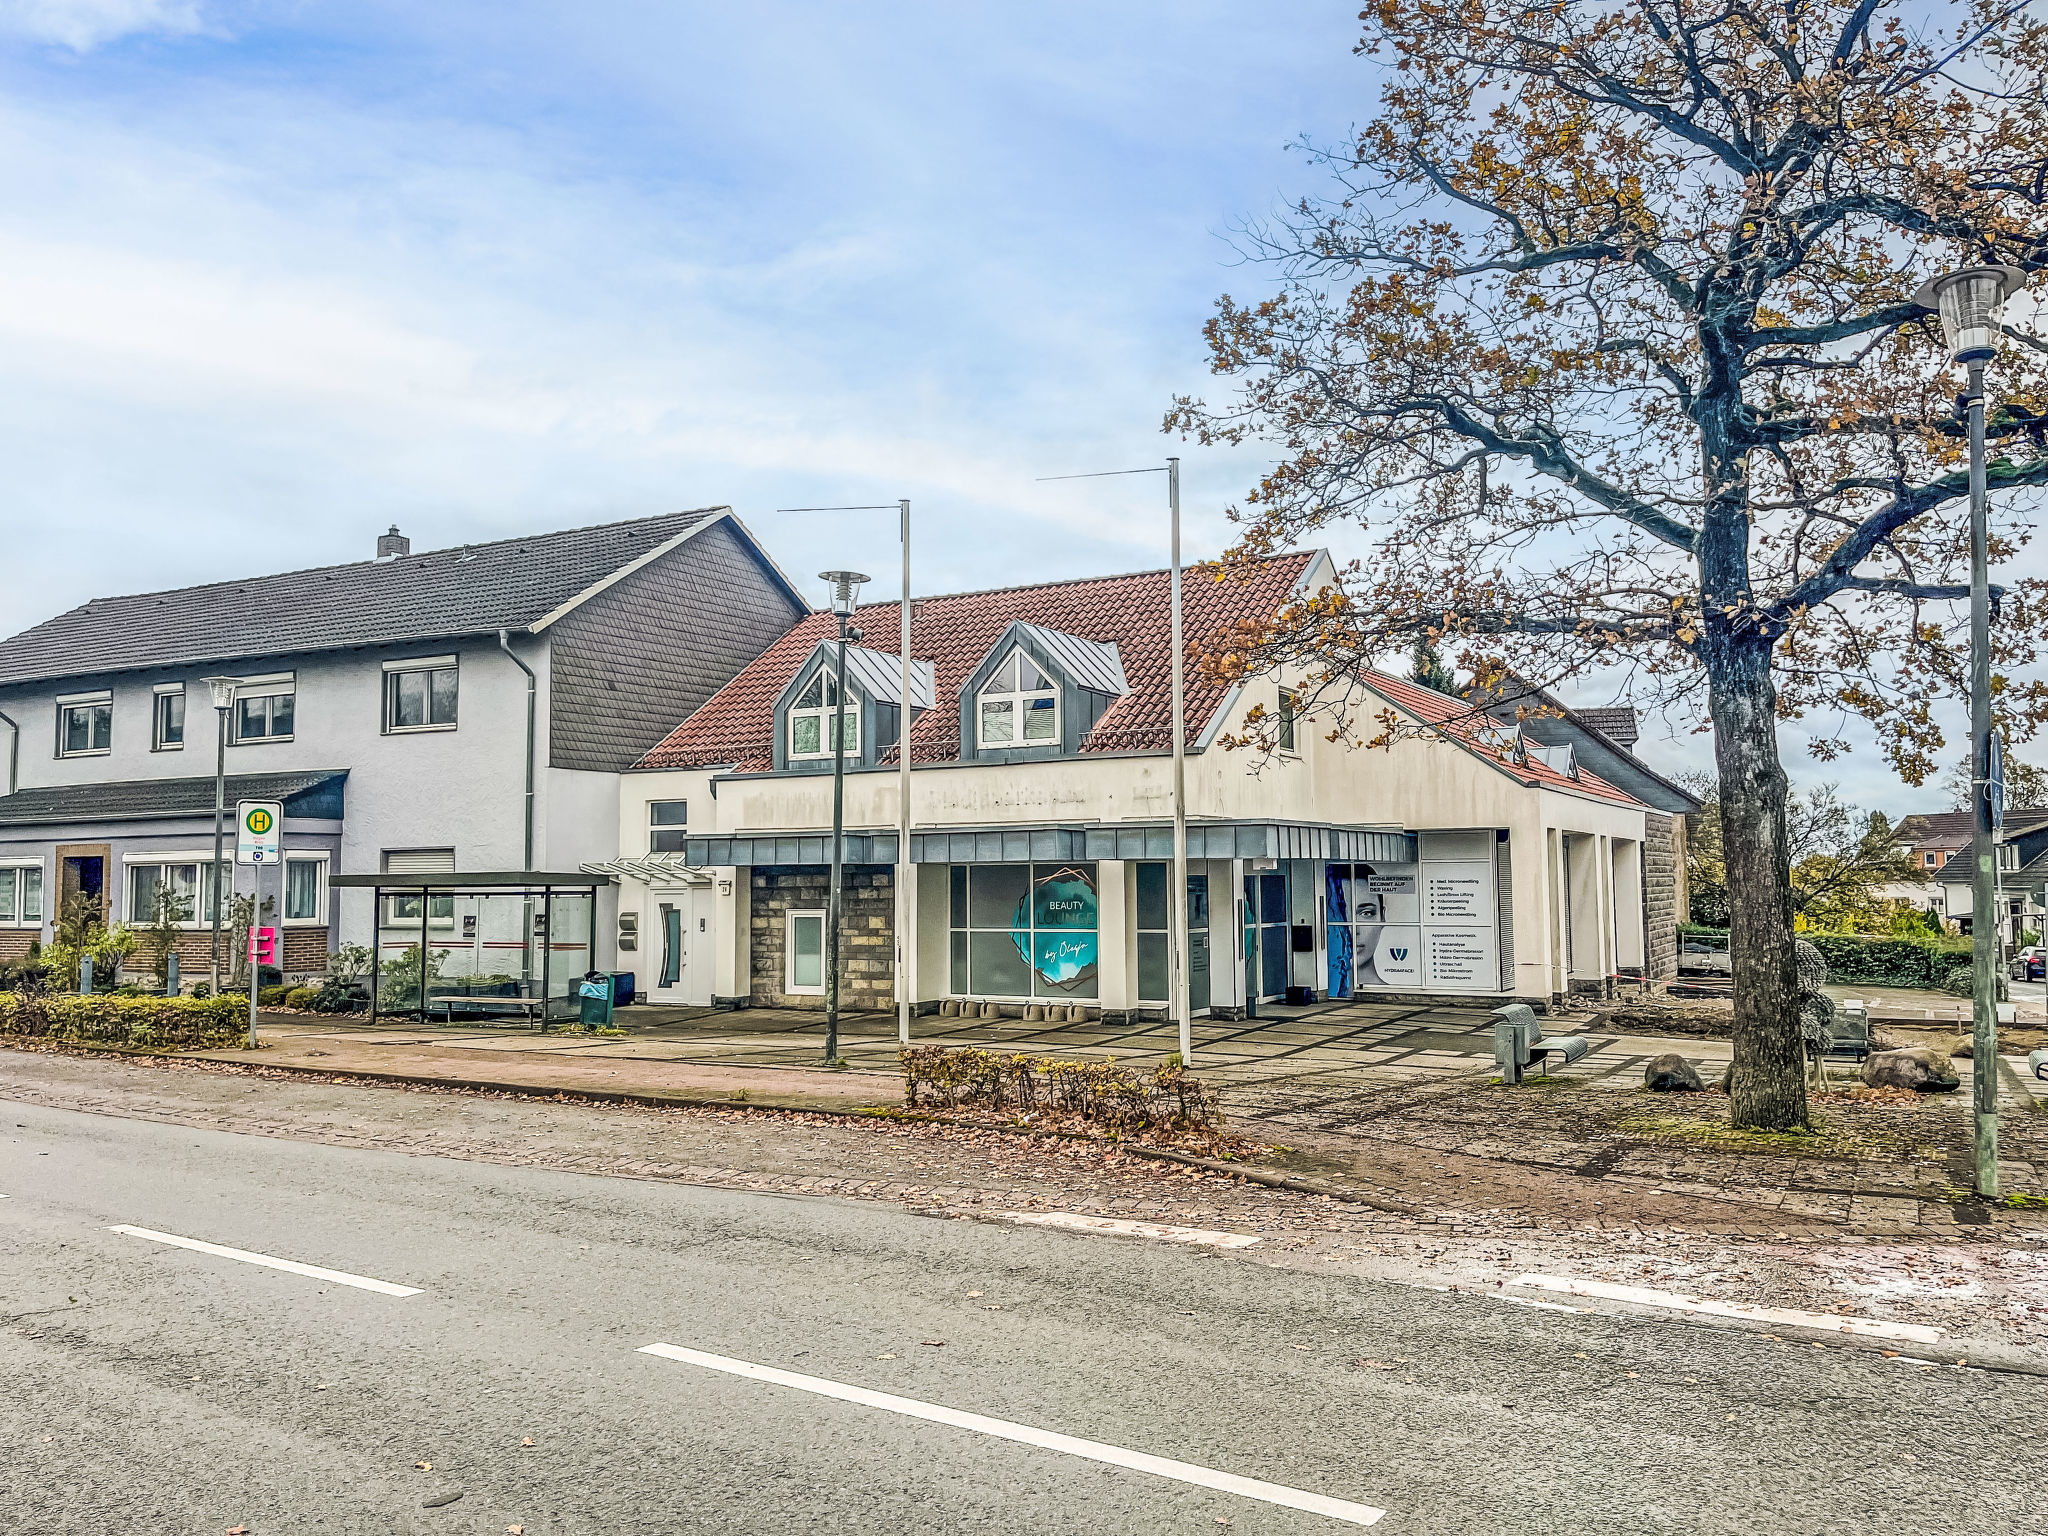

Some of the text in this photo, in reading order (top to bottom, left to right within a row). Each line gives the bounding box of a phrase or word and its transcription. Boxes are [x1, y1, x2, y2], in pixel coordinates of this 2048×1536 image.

[1049, 901, 1084, 910] BEAUTY
[1038, 912, 1094, 925] LOUNGE
[1045, 949, 1057, 963] by
